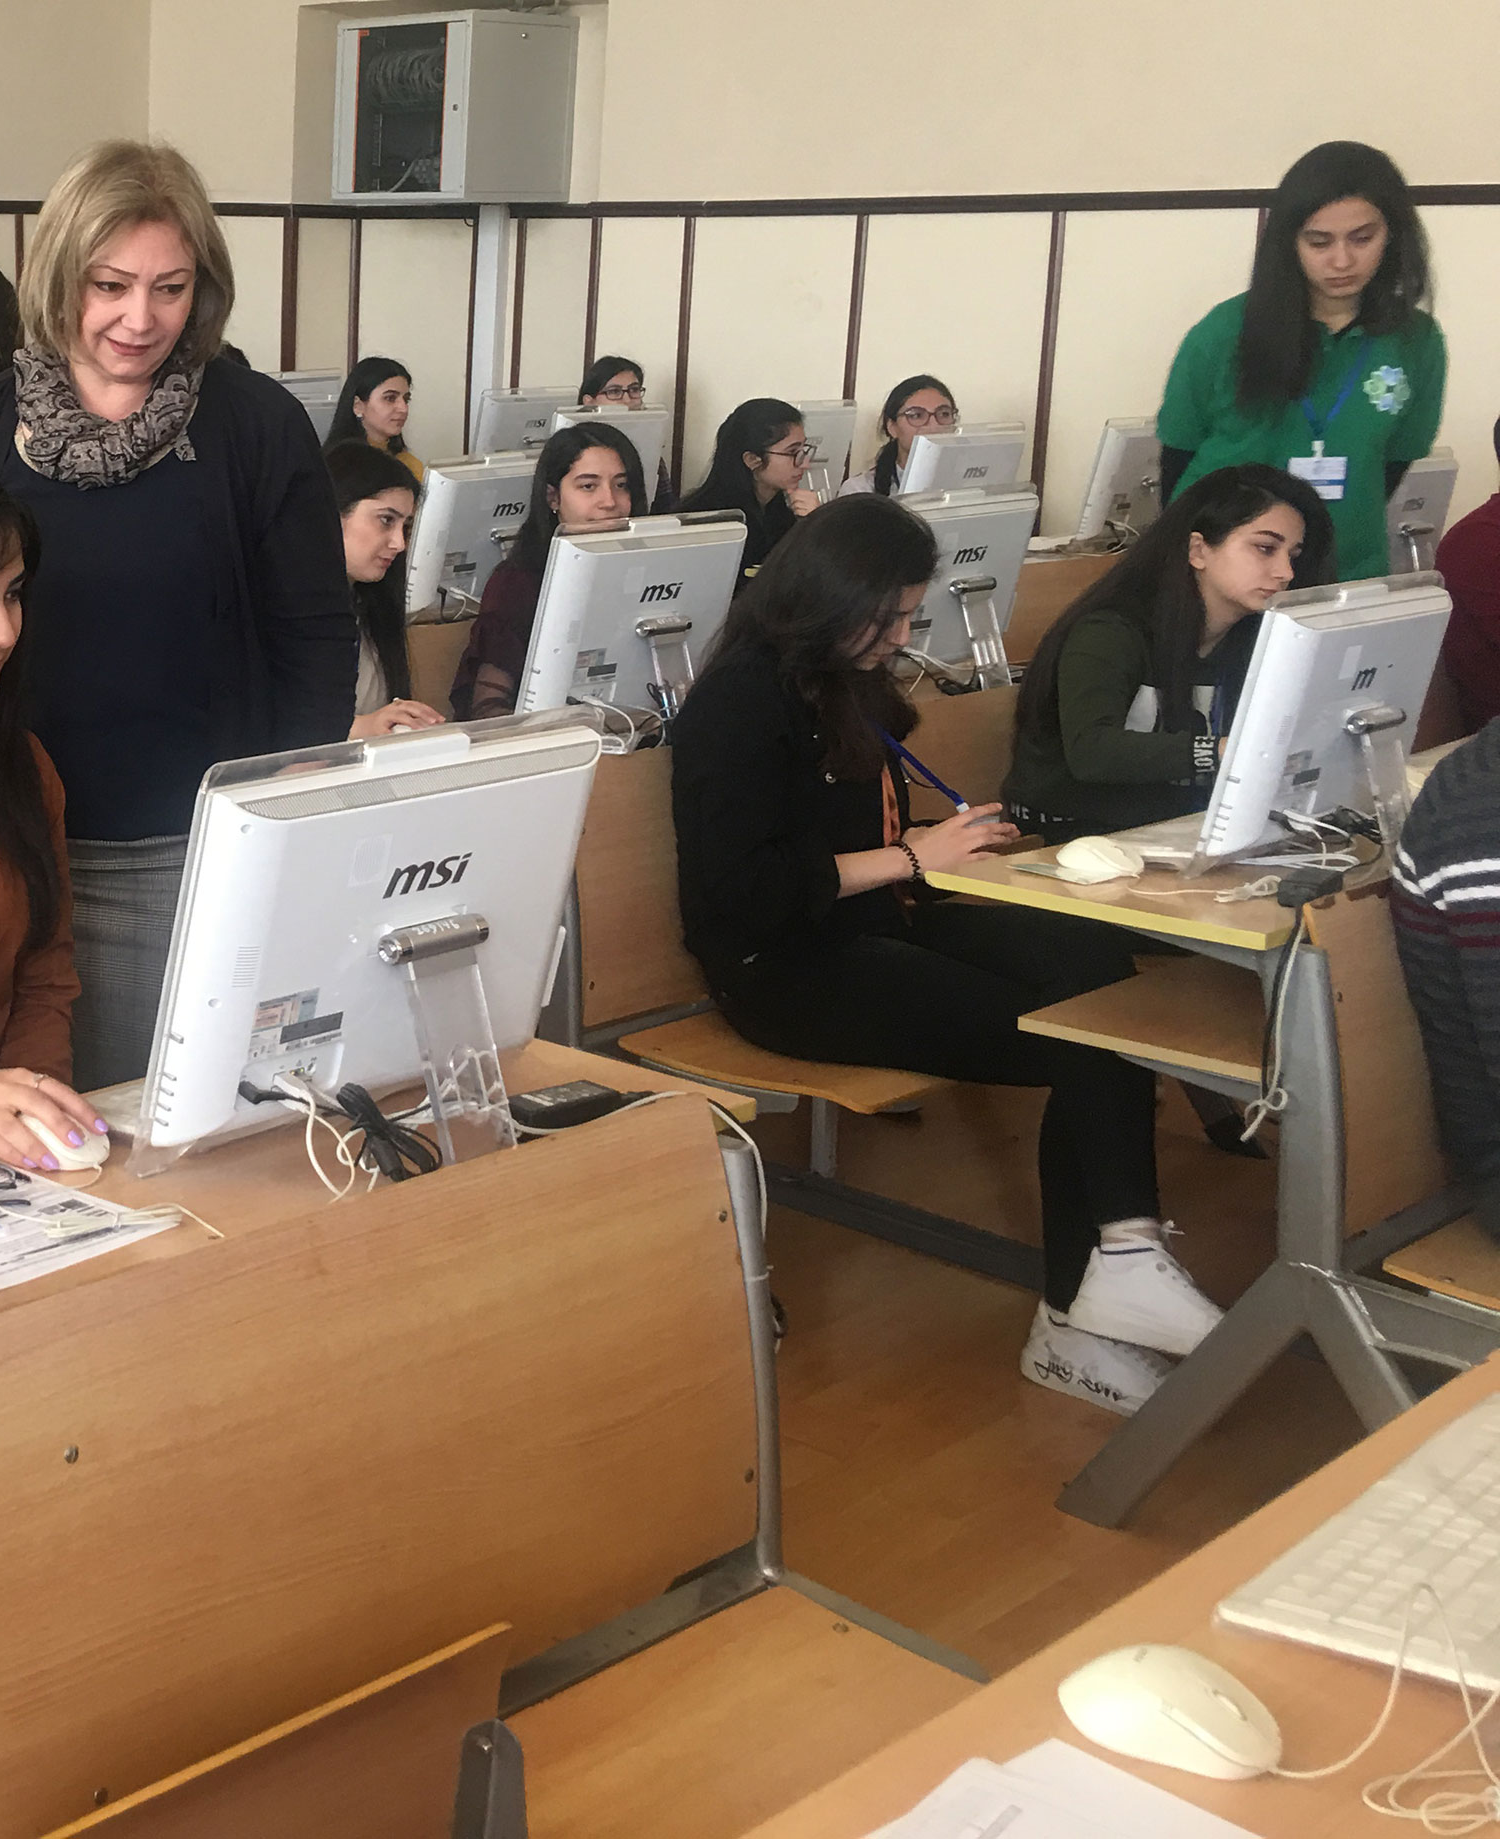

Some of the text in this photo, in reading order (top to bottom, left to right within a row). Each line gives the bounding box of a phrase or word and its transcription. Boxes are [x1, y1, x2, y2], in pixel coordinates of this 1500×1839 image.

[963, 466, 989, 479] msi
[493, 502, 526, 517] msi
[952, 545, 988, 565] msi
[639, 582, 684, 603] msi
[382, 852, 473, 899] msi
